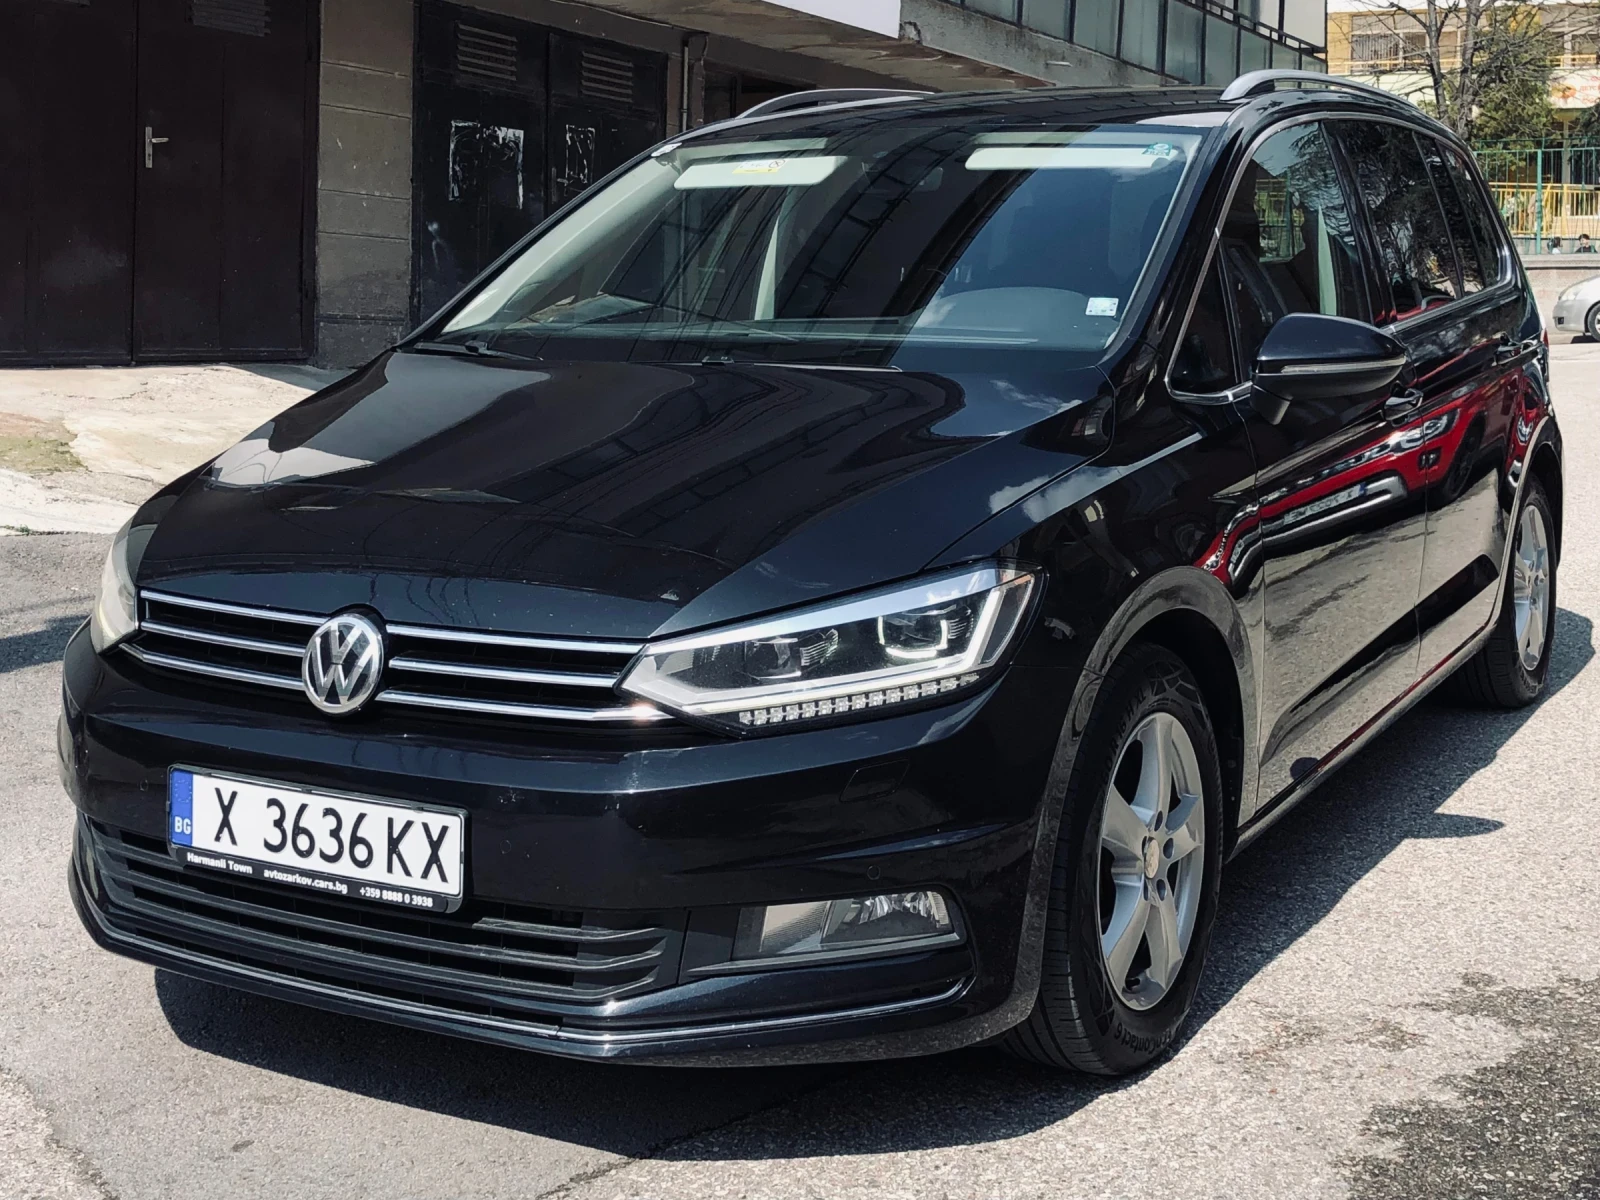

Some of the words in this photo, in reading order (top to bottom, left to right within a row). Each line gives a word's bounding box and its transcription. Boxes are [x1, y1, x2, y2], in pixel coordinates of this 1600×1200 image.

[304, 616, 381, 711] VW
[174, 816, 192, 835] BG
[214, 787, 238, 846] X
[263, 798, 374, 869] 3636
[387, 817, 449, 883] KX
[187, 852, 227, 869] Harmanli
[228, 860, 253, 874] Town
[263, 869, 348, 894] avtozarkov.cars.bg
[360, 887, 381, 898] +359
